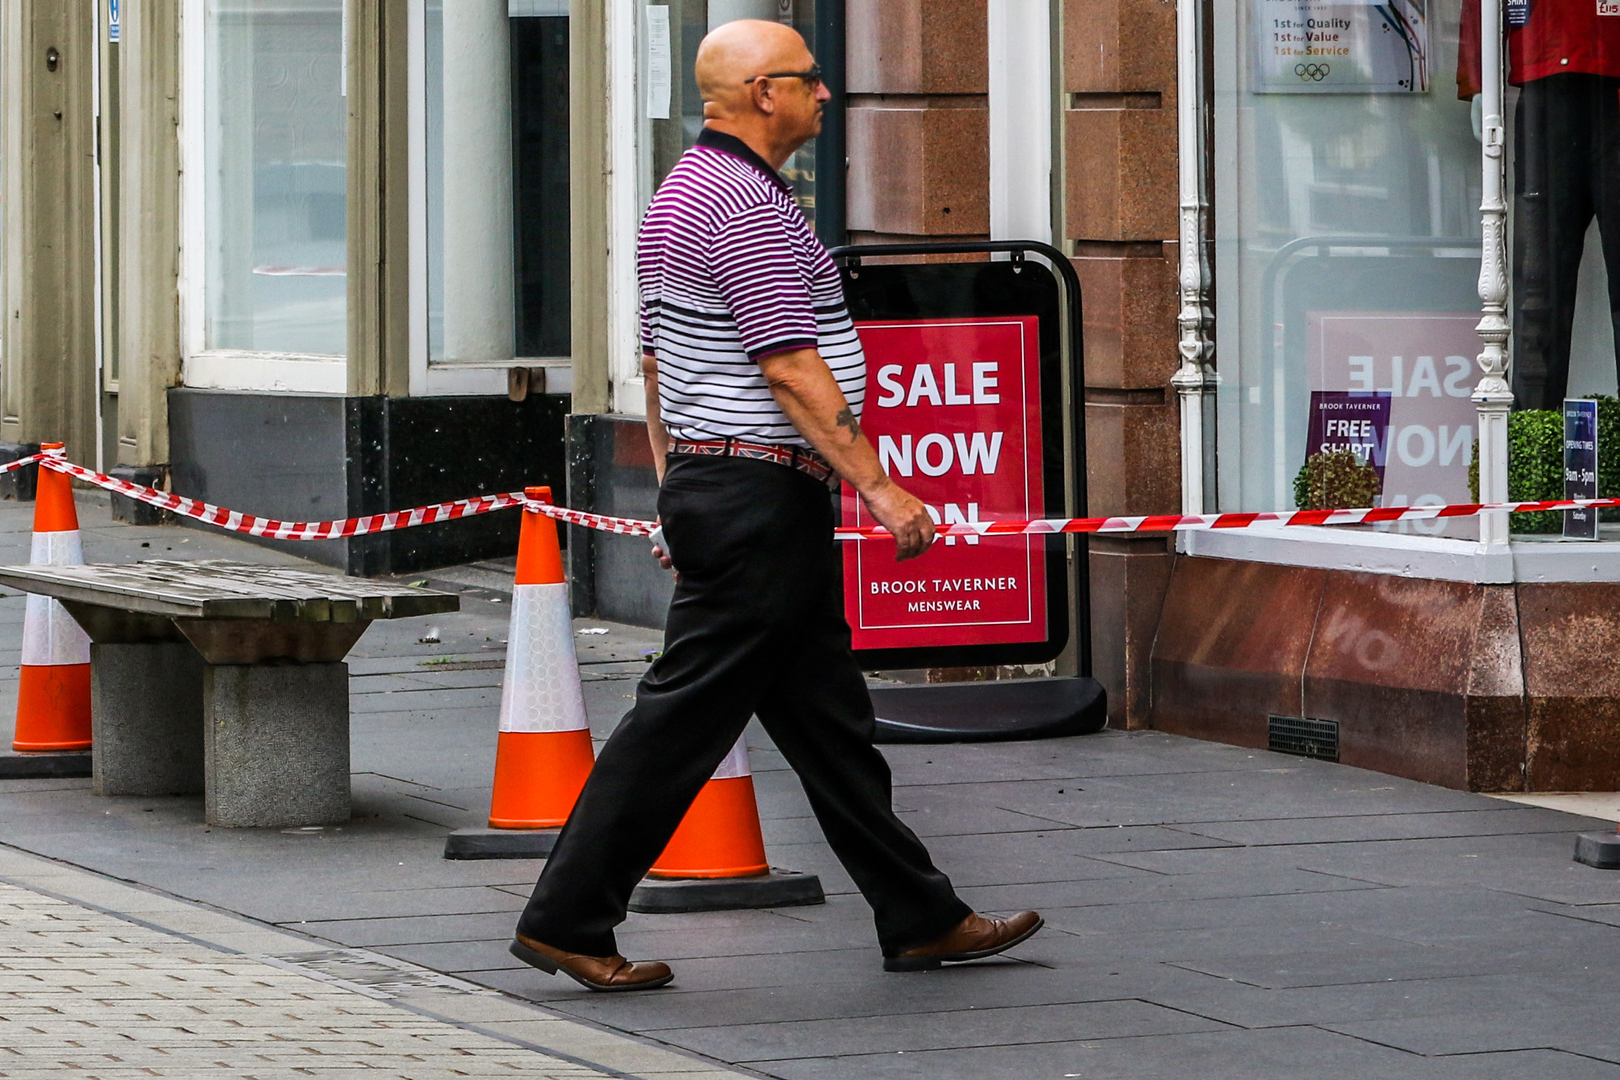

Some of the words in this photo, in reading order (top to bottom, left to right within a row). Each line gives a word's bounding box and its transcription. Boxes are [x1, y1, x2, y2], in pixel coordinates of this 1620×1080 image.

[1599, 1, 1618, 13] £115
[1274, 19, 1291, 28] 1st
[1307, 18, 1351, 30] Quality
[1274, 33, 1291, 42] 1st
[1306, 32, 1339, 41] Value
[1274, 47, 1291, 55] 1st
[1306, 46, 1349, 55] Service
[877, 362, 1000, 408] SALE
[1326, 420, 1371, 437] FREE
[879, 432, 1003, 477] NOW
[1565, 467, 1578, 481] 9am
[1581, 468, 1594, 486] 5pm
[871, 580, 927, 594] BROOK
[933, 577, 1017, 592] TAVERNER
[908, 600, 981, 613] MENSWEAR
